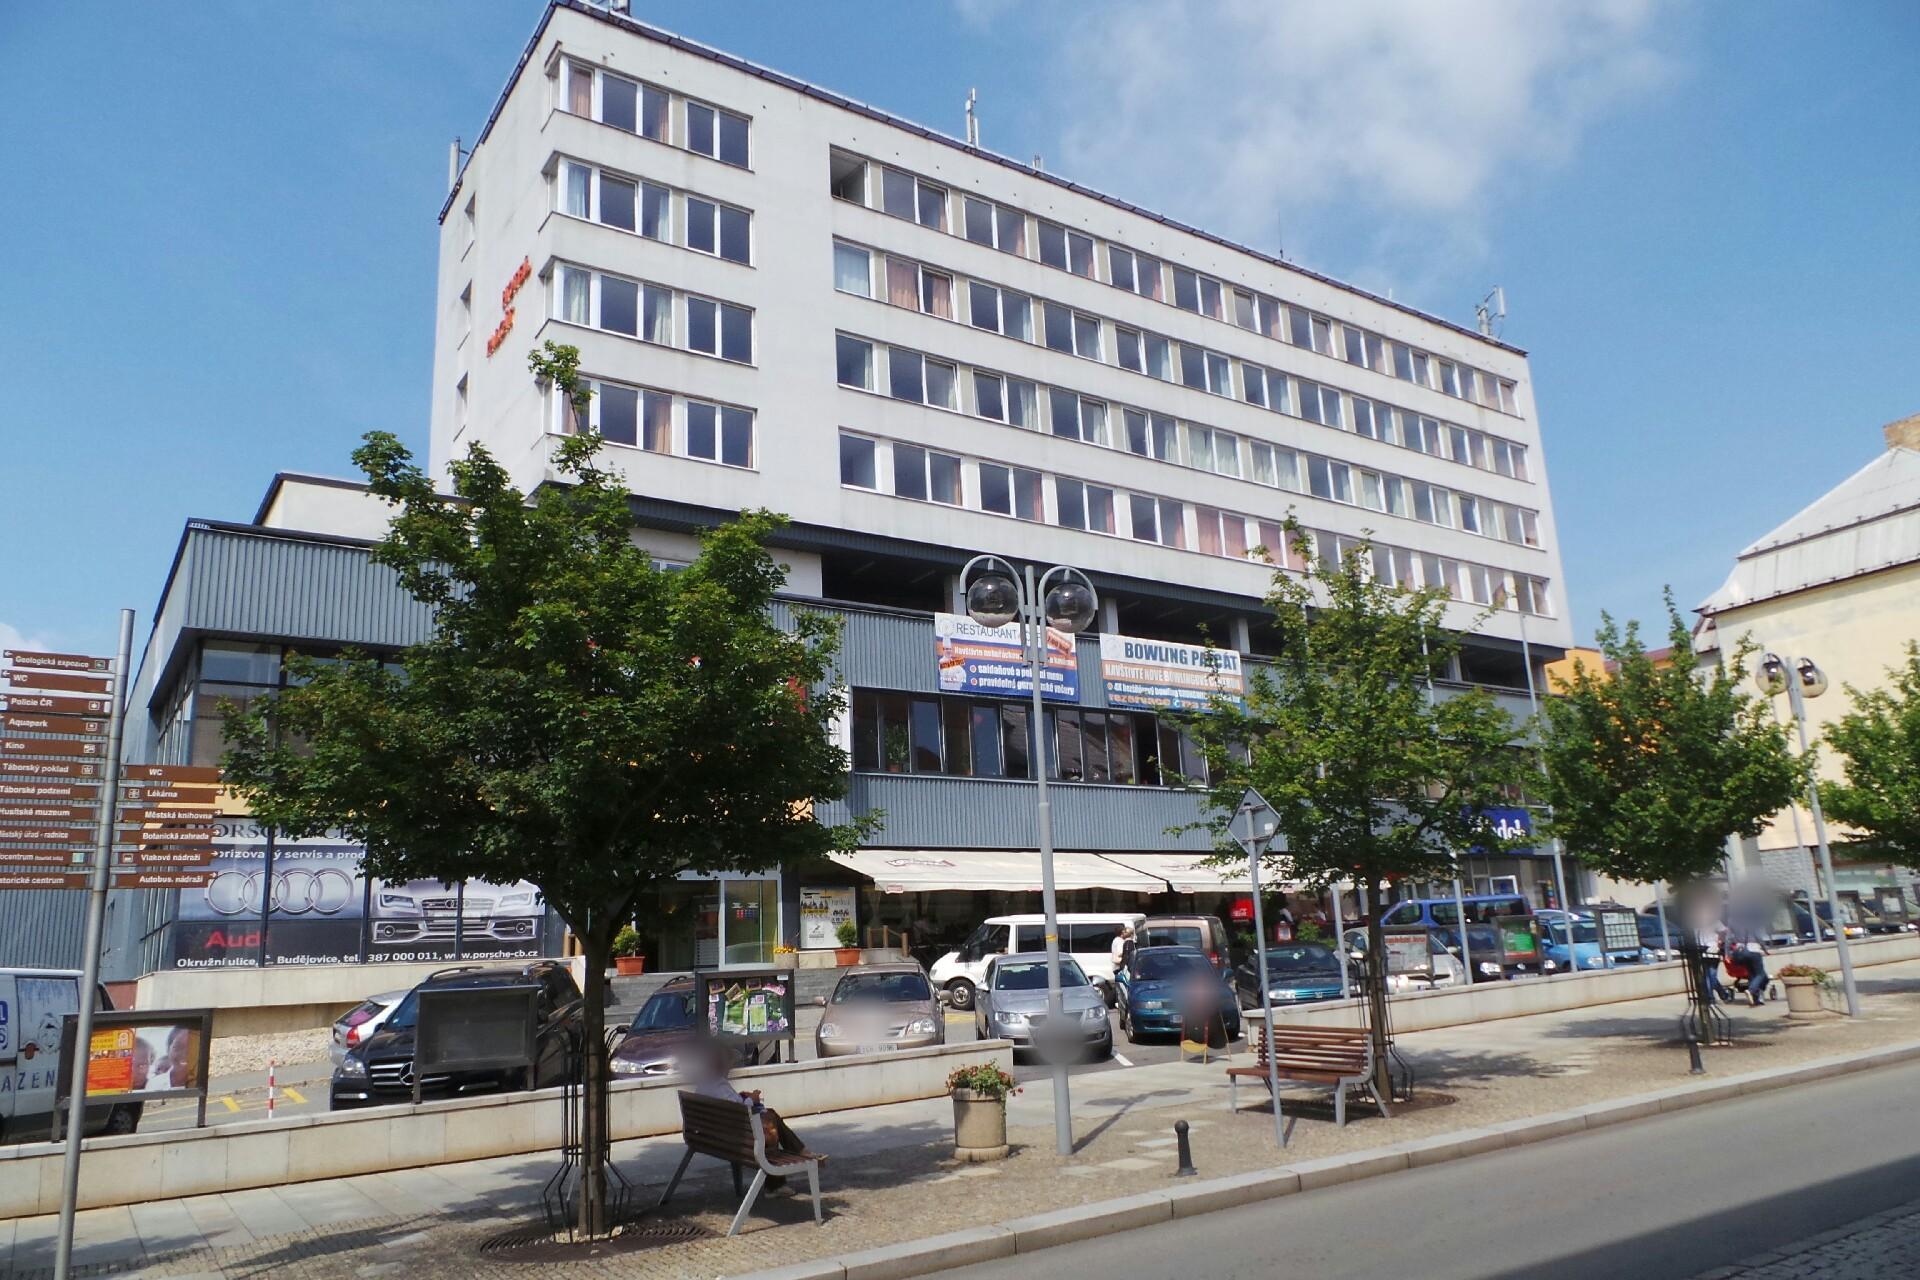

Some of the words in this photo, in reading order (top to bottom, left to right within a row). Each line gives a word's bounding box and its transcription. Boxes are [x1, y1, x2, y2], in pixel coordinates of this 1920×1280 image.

[956, 623, 1017, 640] RESTAURANT
[15, 655, 56, 666] Geologická
[1124, 642, 1189, 664] BOWLING
[1191, 649, 1238, 671] PACÁT
[13, 674, 28, 682] WC
[10, 697, 39, 706] Policie
[39, 698, 53, 707] ČR
[8, 718, 48, 728] Aquapark
[5, 742, 25, 750] Kino
[2, 762, 40, 773] Táborský
[41, 764, 69, 773] poklad
[148, 768, 163, 776] WC
[0, 785, 36, 794] Táborské
[37, 787, 71, 795] podzemí
[147, 789, 178, 798] Lékárna
[144, 810, 176, 819] Městská
[177, 811, 213, 819] knihovna
[0, 830, 22, 839] ěstský
[43, 830, 69, 838] radnice
[142, 832, 178, 840] Botanická
[179, 832, 209, 840] zahrada
[141, 853, 171, 861] Vlakové
[172, 853, 201, 861] nádraží
[284, 849, 323, 859] servis
[139, 875, 173, 883] Autobus.
[175, 875, 204, 883] nádraží
[206, 930, 268, 949] Aud
[177, 957, 226, 967] Okružní
[228, 957, 259, 967] ulice,
[276, 954, 340, 966] Budějovice,
[343, 953, 361, 963] tel.
[367, 953, 389, 962] 387
[392, 952, 415, 961] 000
[417, 952, 442, 961] 011,
[444, 950, 538, 961] ww.porsche-cb.cz
